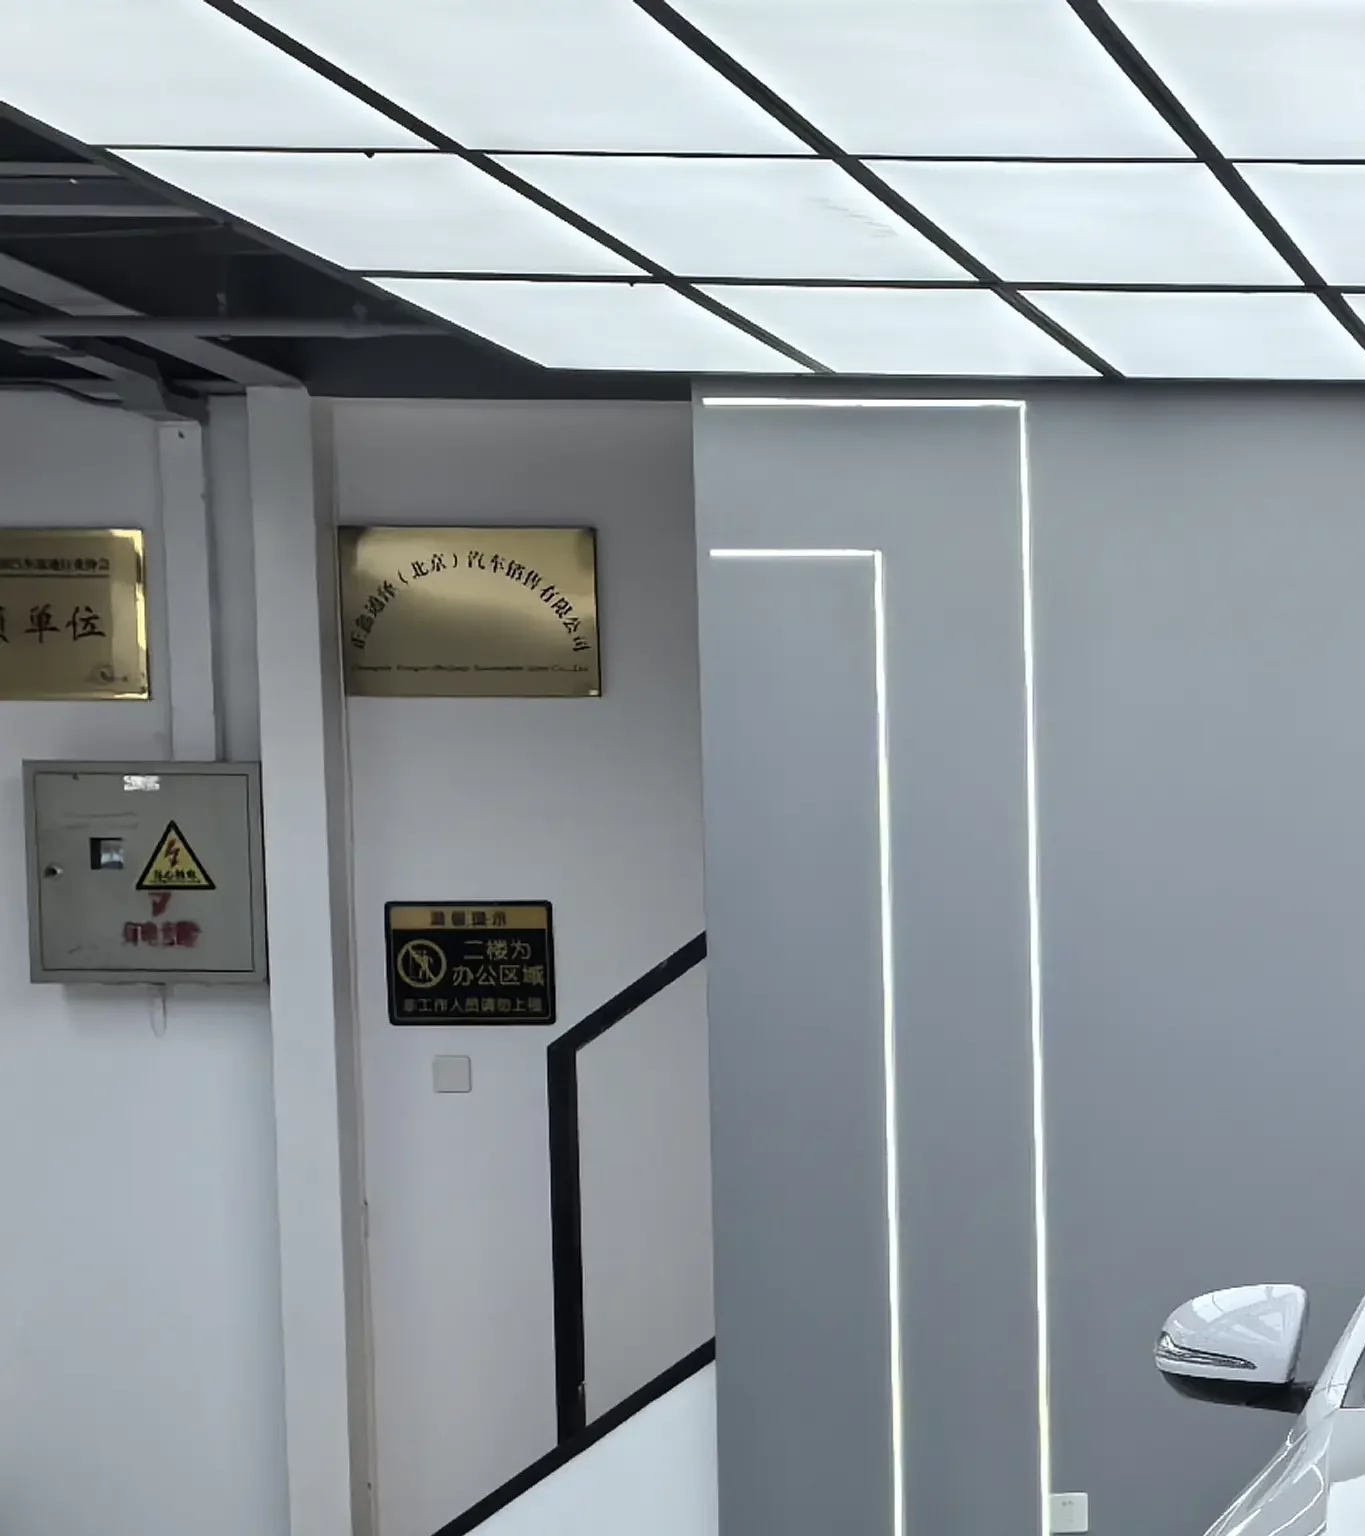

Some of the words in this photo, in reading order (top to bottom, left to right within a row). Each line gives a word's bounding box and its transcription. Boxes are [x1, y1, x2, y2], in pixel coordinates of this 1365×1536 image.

[464, 939, 531, 961] 二楼为
[452, 965, 545, 987] 办公区域
